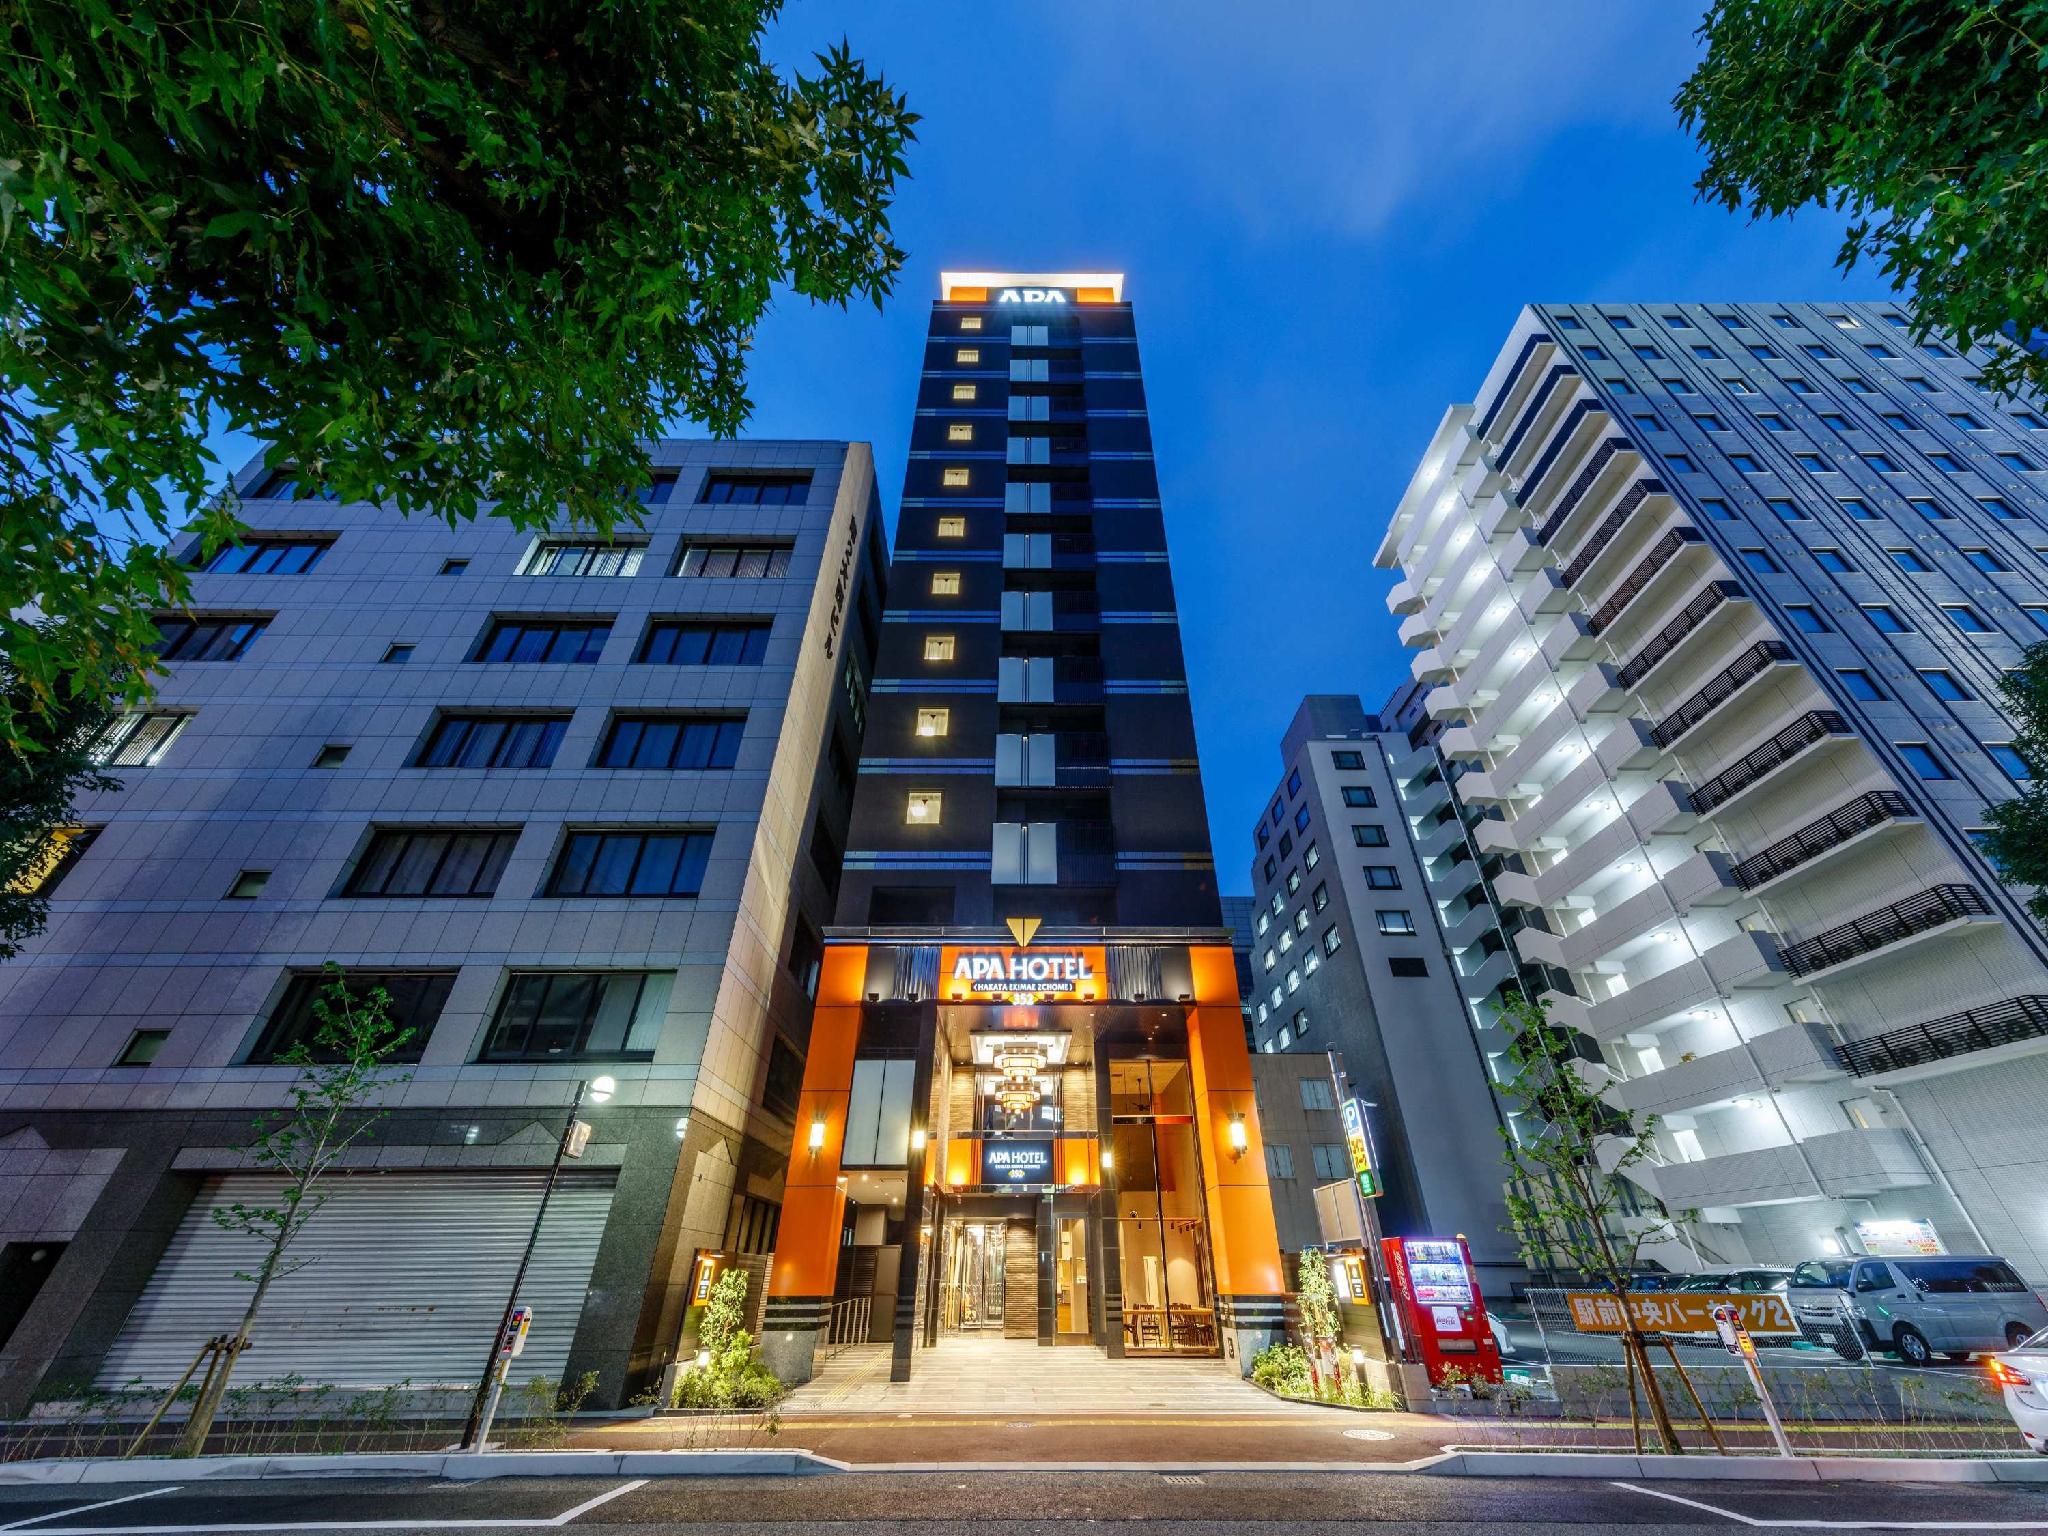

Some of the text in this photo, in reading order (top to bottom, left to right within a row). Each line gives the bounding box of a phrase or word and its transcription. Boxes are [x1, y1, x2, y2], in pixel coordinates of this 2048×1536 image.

[999, 290, 1066, 303] APA
[954, 957, 1093, 980] APA HOTEL
[1009, 983, 1036, 991] EKIMAE
[1345, 1106, 1356, 1129] P
[989, 1151, 1047, 1164] APA HOTEL
